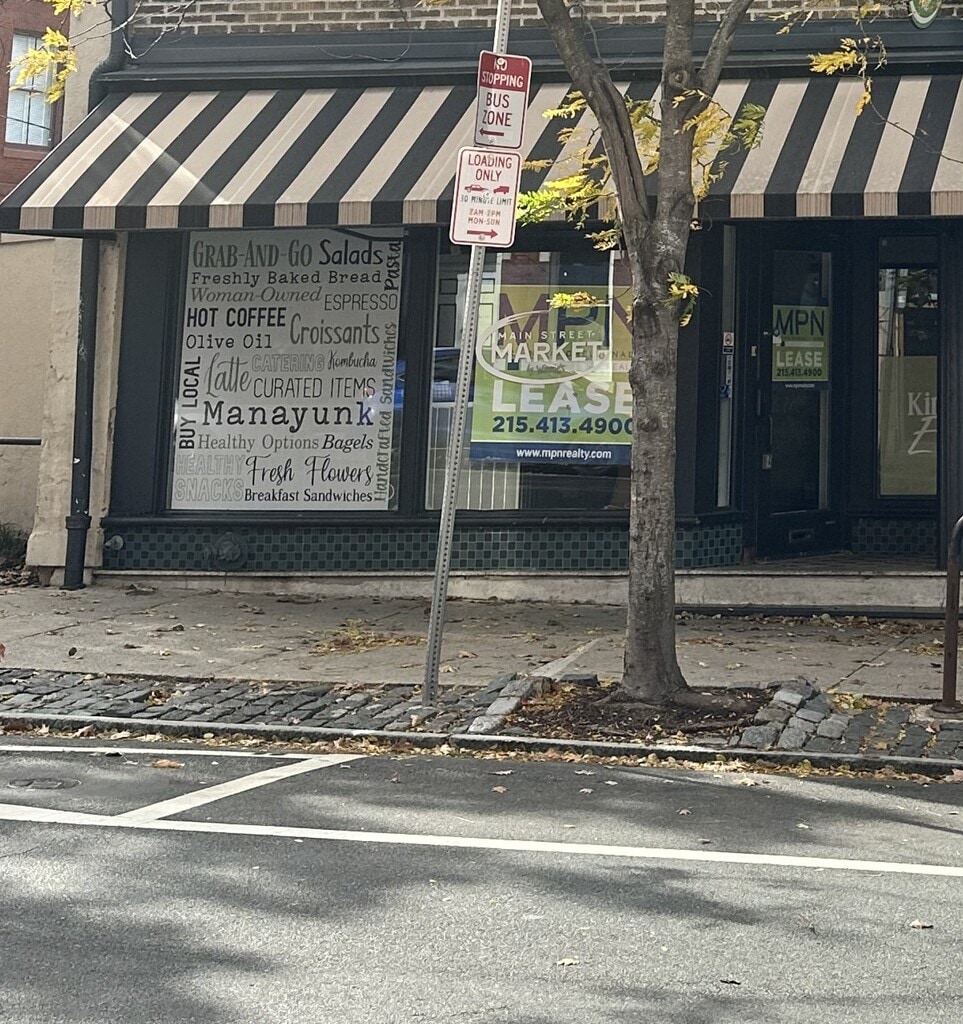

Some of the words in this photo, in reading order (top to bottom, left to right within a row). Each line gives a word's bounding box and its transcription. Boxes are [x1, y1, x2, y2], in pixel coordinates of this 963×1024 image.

[482, 72, 524, 88] STOPPING
[486, 92, 510, 108] BUS
[482, 110, 512, 127] ZONE
[468, 154, 512, 169] LOADING
[475, 169, 502, 182] ONLY
[496, 197, 513, 206] LIMIT
[319, 239, 384, 266] Salads
[384, 241, 402, 292] Pasta
[192, 272, 260, 287] Freshly
[268, 271, 321, 285] Baked
[328, 270, 382, 284] Bread
[191, 286, 323, 303] Woman-Owned
[324, 293, 398, 311] ESPRESSO
[187, 308, 219, 327] HOT
[226, 307, 287, 327] COFFEE
[775, 309, 825, 337] MPN
[290, 313, 381, 345] Croissants
[499, 331, 532, 341] MAIN
[541, 330, 591, 340] STREET
[186, 334, 235, 349] Olive
[243, 333, 273, 349] Oil
[251, 354, 325, 372] CATERING
[328, 350, 377, 371] Kombucha
[491, 341, 603, 363] MARKET
[776, 350, 823, 367] LEASE
[380, 322, 397, 405] Sandwiches
[182, 356, 202, 408] LOCAL
[204, 352, 252, 398] Latte
[253, 377, 323, 398] CURATED
[330, 377, 376, 398] ITEMS
[492, 380, 632, 415] LEASE
[202, 400, 374, 433] Manayunk
[179, 416, 197, 450] BUY
[198, 434, 256, 453] Healthy
[262, 434, 319, 454] Options
[321, 434, 374, 451] Bagels
[516, 448, 612, 461] www.mpnrealty.com
[175, 454, 246, 475] HEALTHY
[374, 411, 392, 502] Handcrafted
[246, 455, 294, 486] Fresh
[305, 455, 374, 486] Flowers
[174, 478, 245, 501] SNACKS
[244, 488, 300, 502] Breakfast
[303, 488, 373, 502] Sandwiches
